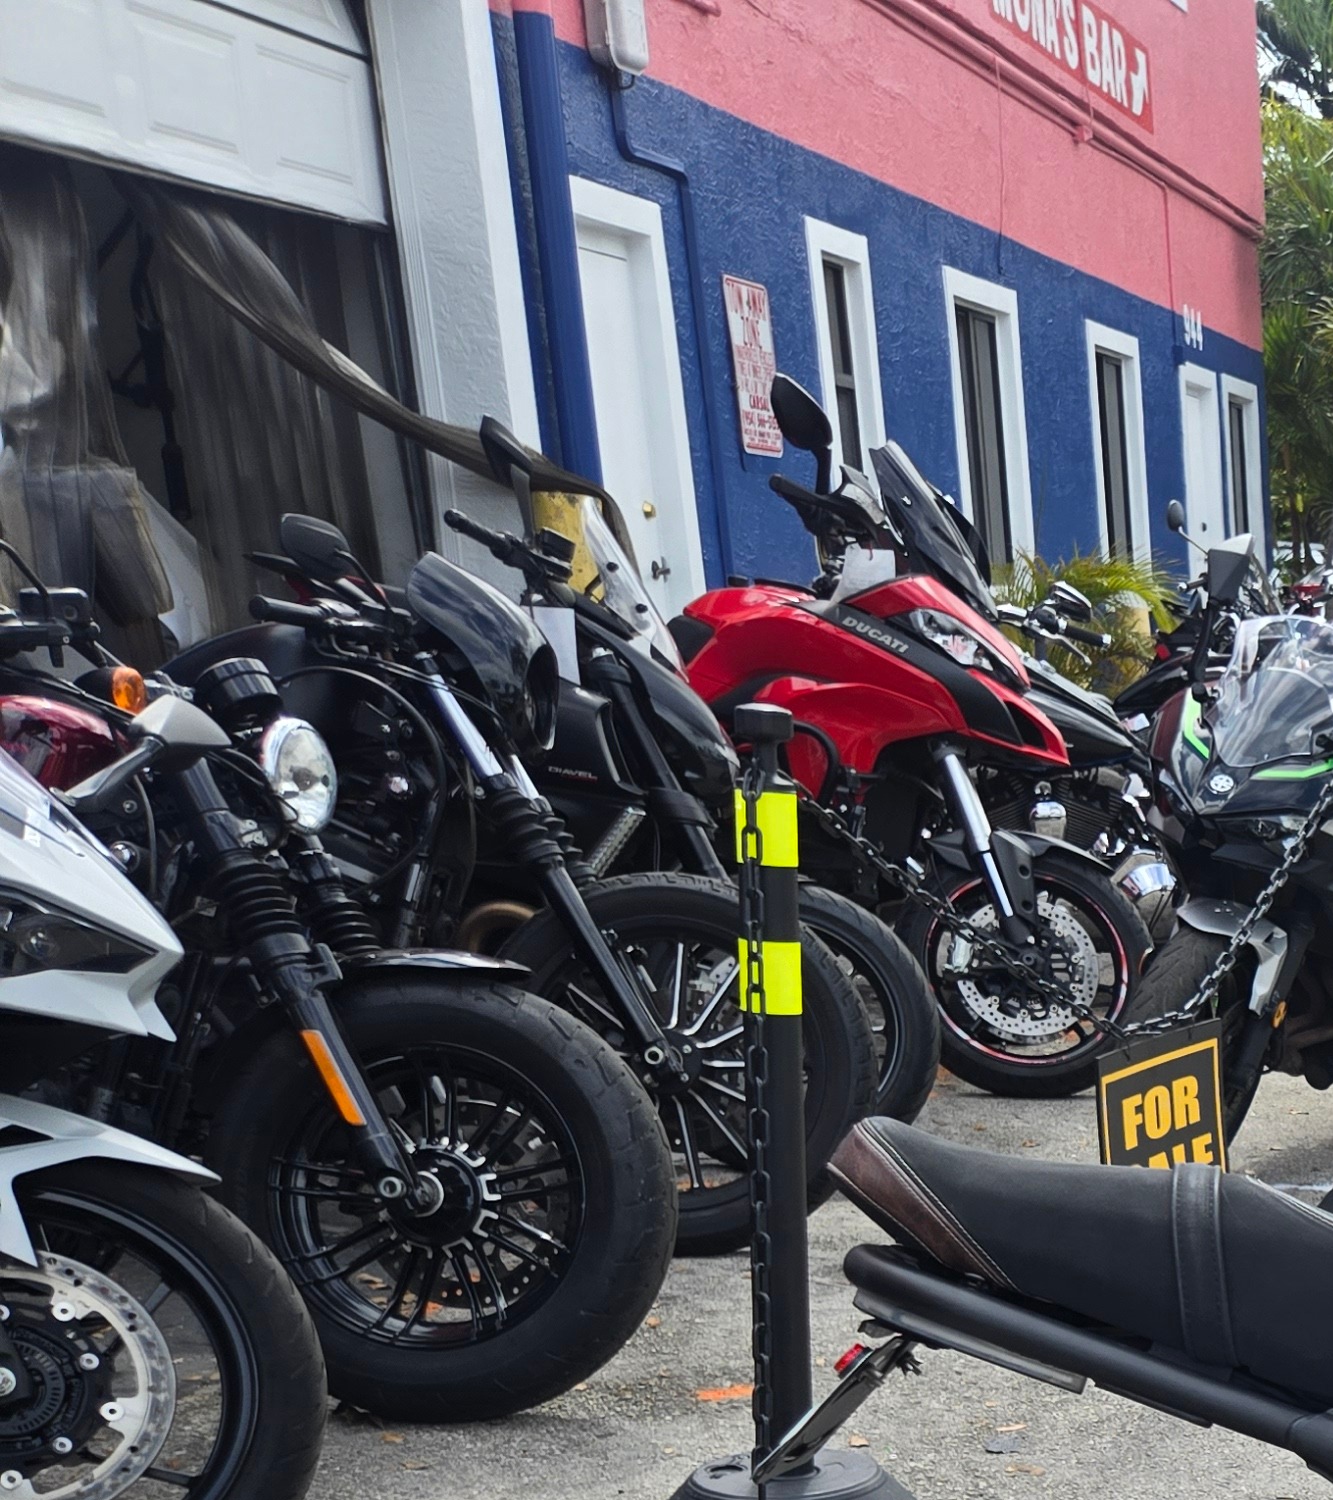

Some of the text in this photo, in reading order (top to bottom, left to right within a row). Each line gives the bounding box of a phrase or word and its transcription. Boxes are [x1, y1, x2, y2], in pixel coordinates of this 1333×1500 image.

[1082, 3, 1128, 108] BAR
[1183, 303, 1203, 351] 944
[842, 616, 909, 653] DUCATI
[1122, 1075, 1201, 1151] FOR
